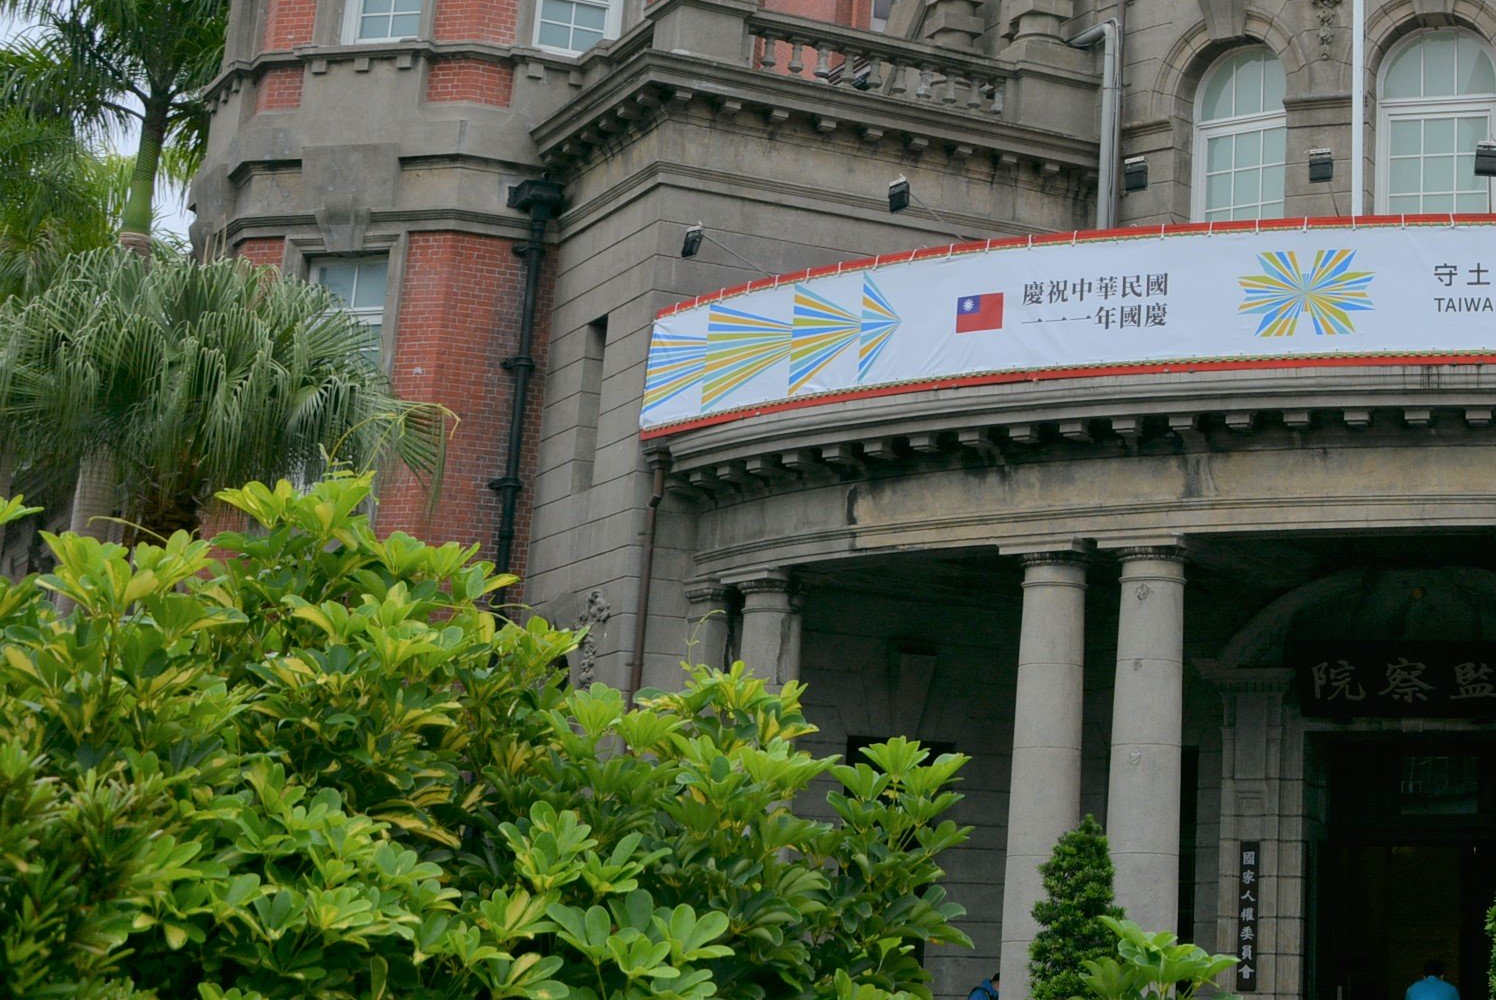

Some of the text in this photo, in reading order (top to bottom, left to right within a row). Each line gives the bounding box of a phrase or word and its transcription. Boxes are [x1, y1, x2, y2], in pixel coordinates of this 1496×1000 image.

[1022, 272, 1169, 306] 慶祝中華民國
[1021, 302, 1169, 330] 一一一年國慶
[1237, 850, 1257, 979] 國家人權委員會
